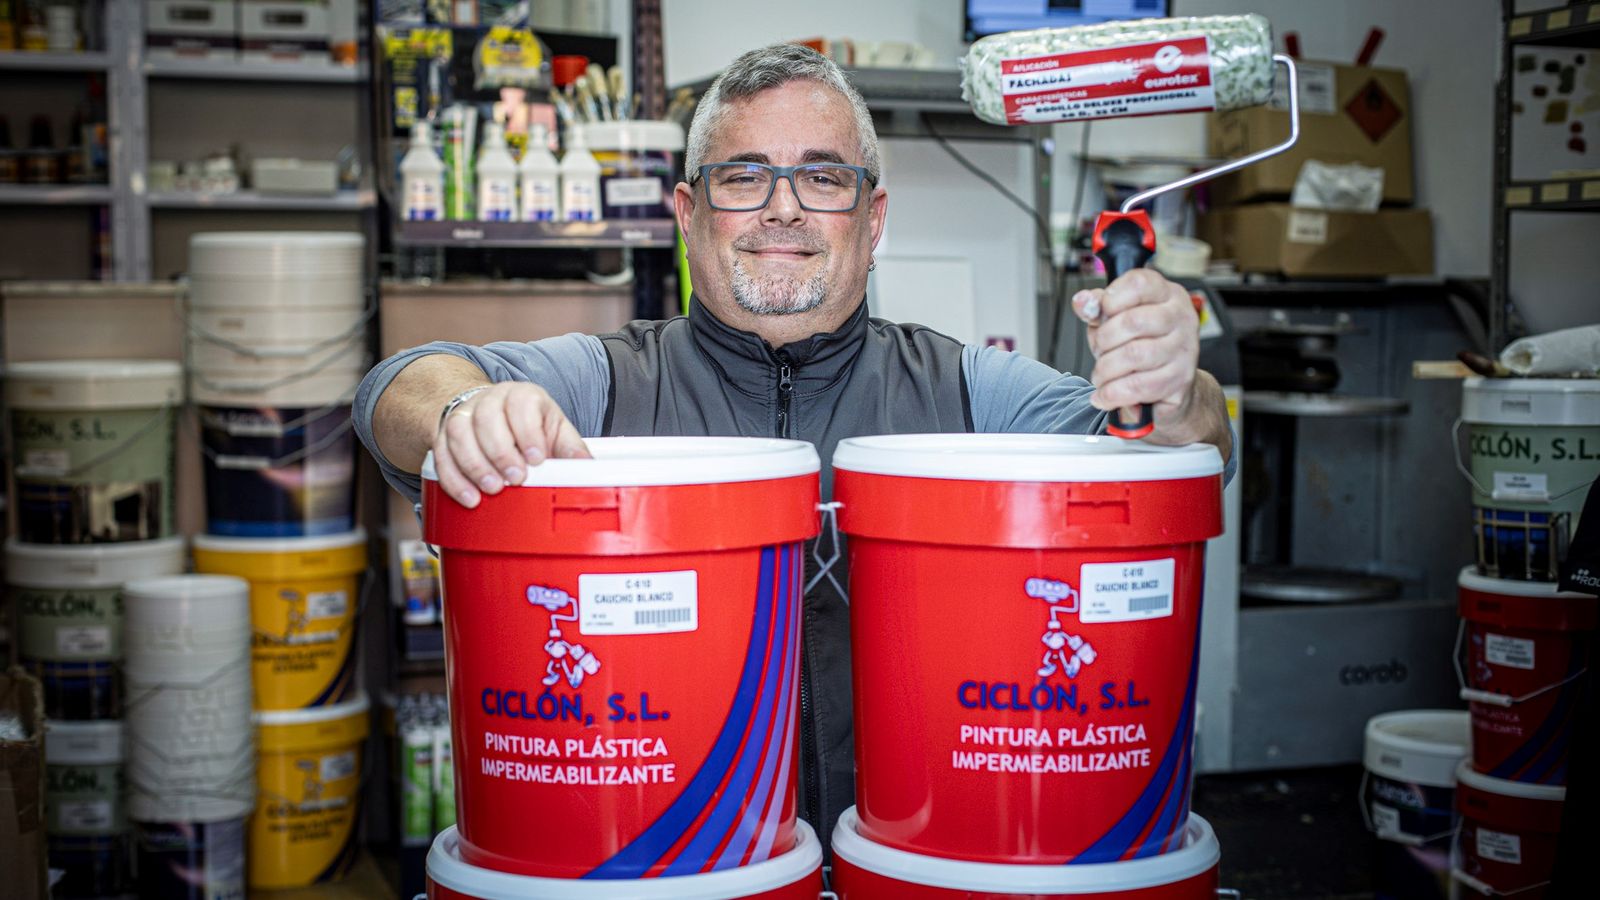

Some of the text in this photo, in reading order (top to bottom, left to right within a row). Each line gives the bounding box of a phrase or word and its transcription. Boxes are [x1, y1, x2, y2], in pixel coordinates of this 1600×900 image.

[1144, 72, 1199, 89] eurotex
[1035, 102, 1081, 113] RODILLO
[594, 591, 674, 604] CAUCHO BLANCO
[1095, 579, 1159, 593] CAUCHO BLANCO
[1340, 657, 1408, 686] corob
[481, 687, 670, 728] CICLÓN, S.L.
[958, 677, 1150, 716] CICLÓN, S.L.
[484, 732, 668, 758] PINTURA PLÁSTICA
[960, 723, 1147, 747] PINTURA PLÁSTICA
[481, 757, 675, 785] IMPERMEABILIZANTE
[952, 748, 1151, 773] IMPERMEABILIZANTE
